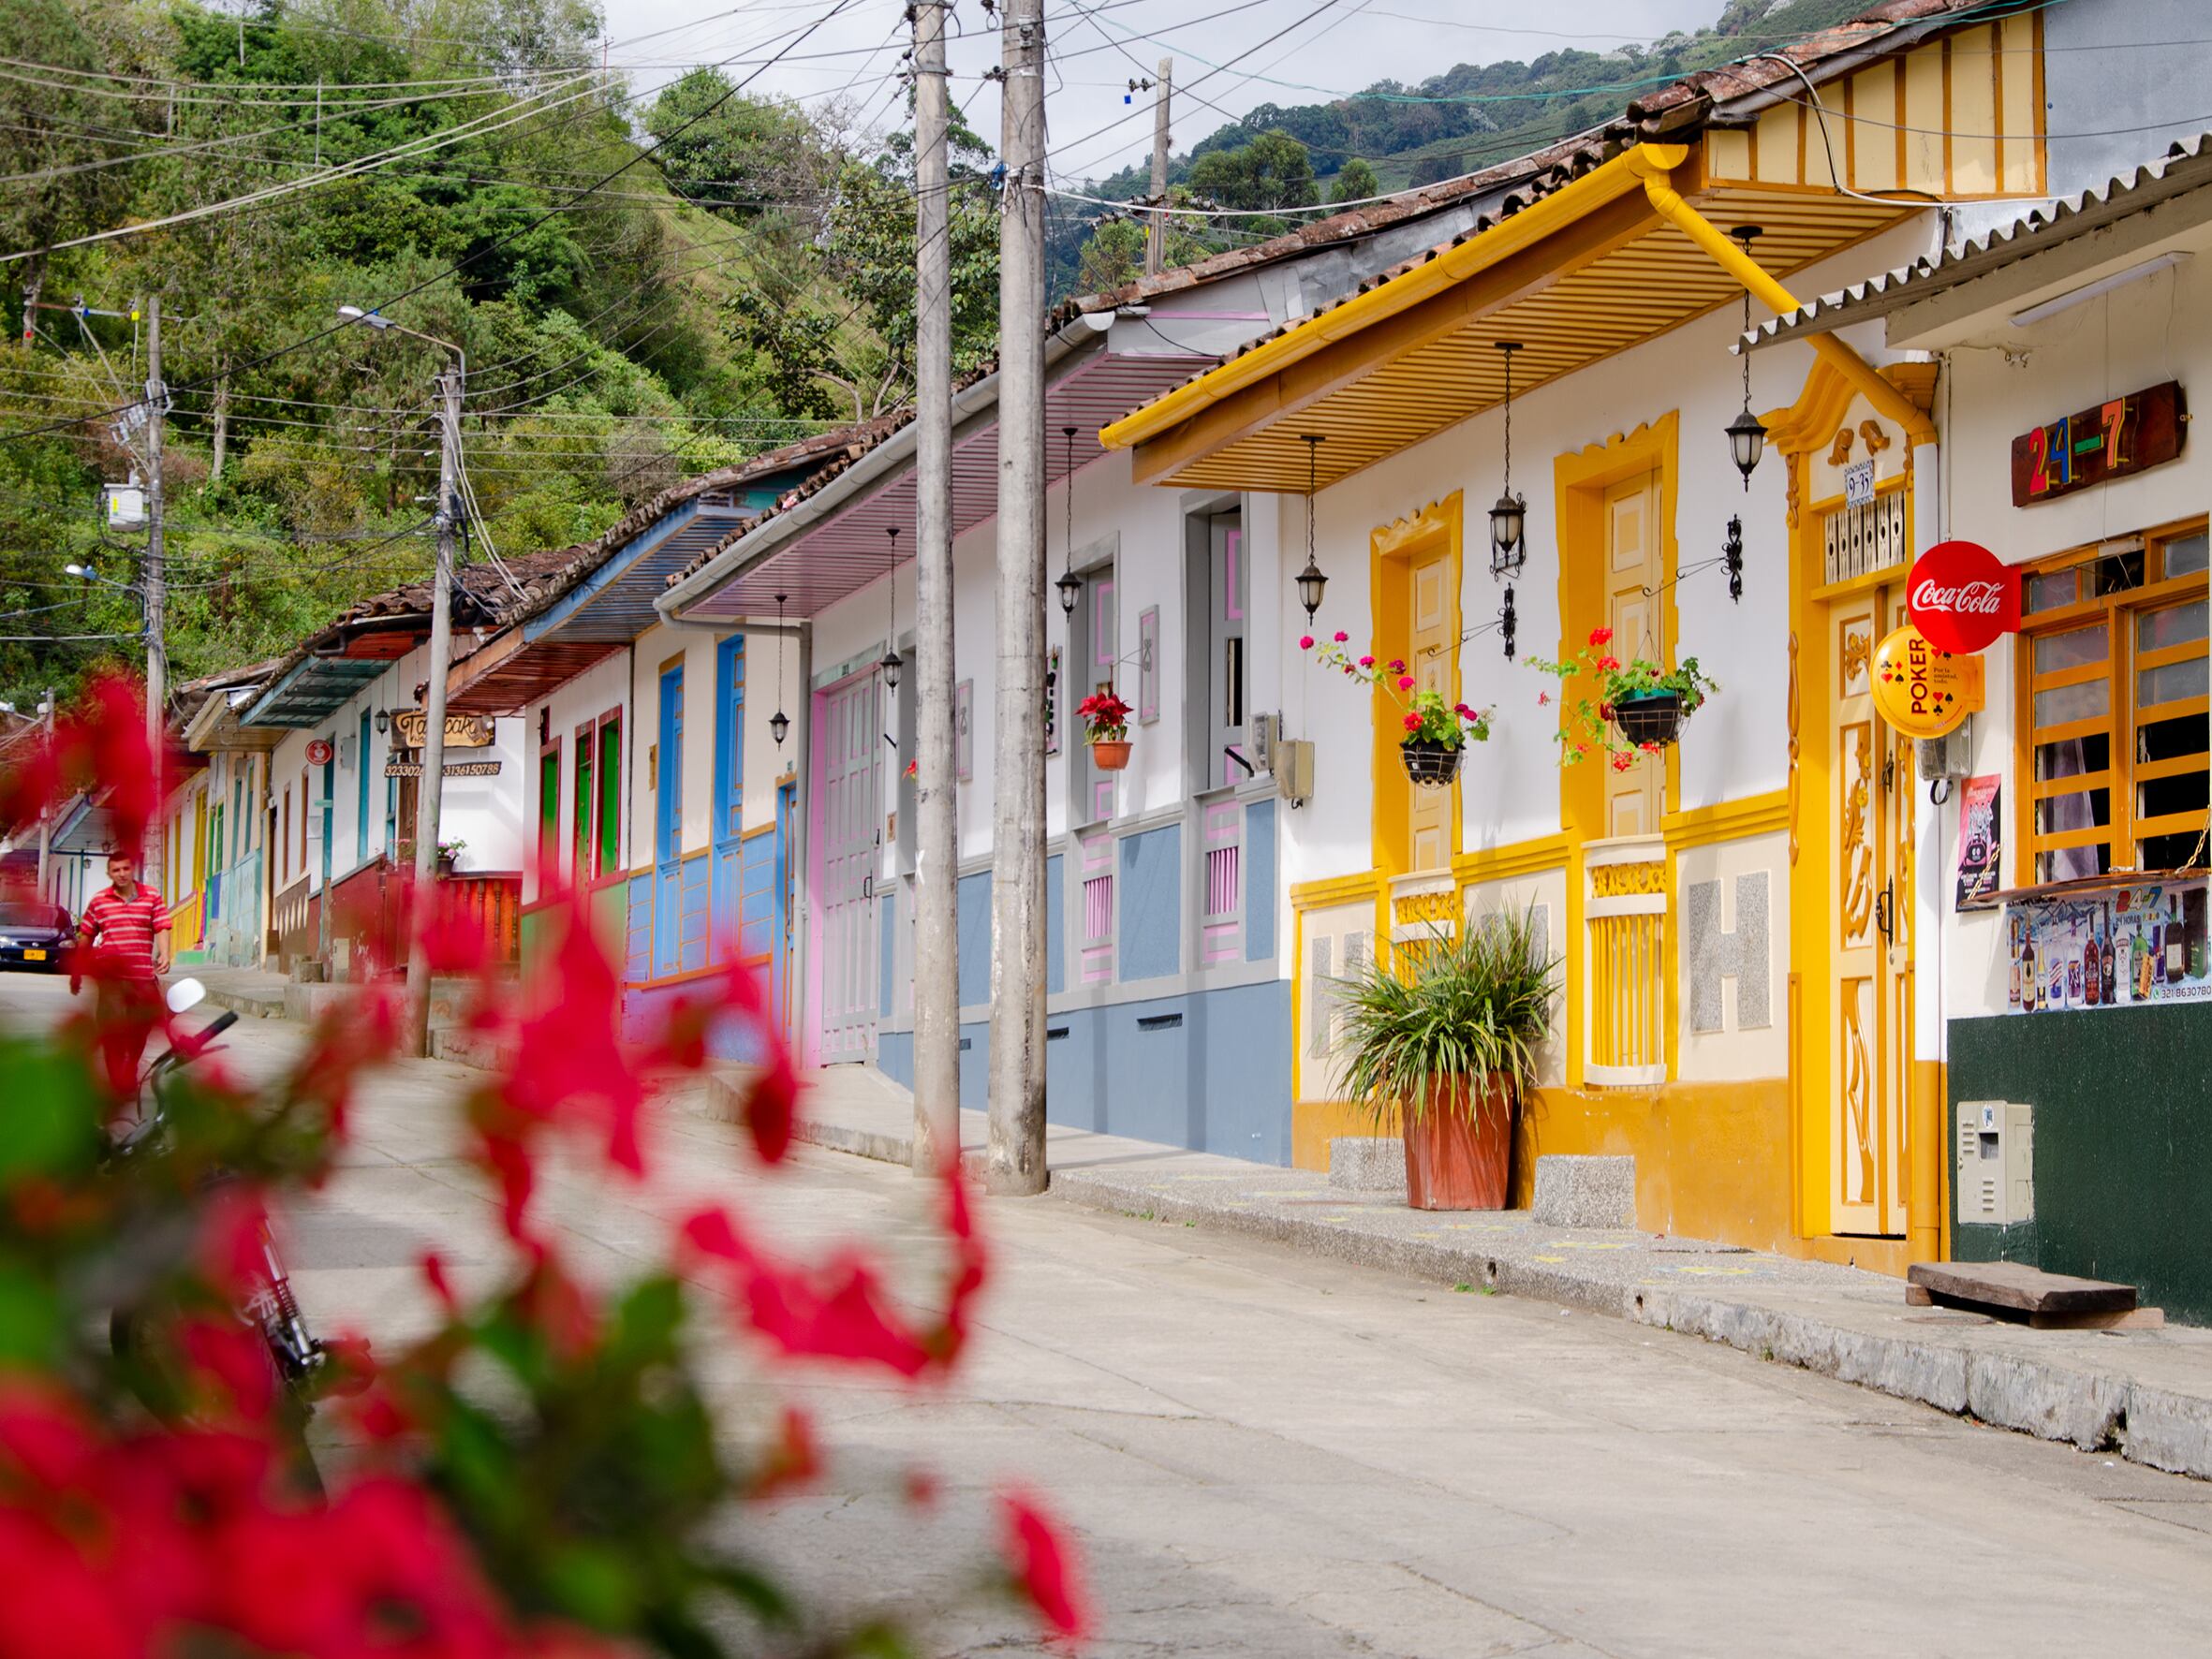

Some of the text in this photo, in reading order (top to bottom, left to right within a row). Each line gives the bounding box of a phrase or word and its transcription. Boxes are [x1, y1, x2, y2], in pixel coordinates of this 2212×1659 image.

[2028, 397, 2126, 495] 24-7
[1849, 472, 1869, 499] 9-35
[1911, 578, 2005, 614] Coca-Cola
[1909, 639, 1927, 714] POKER
